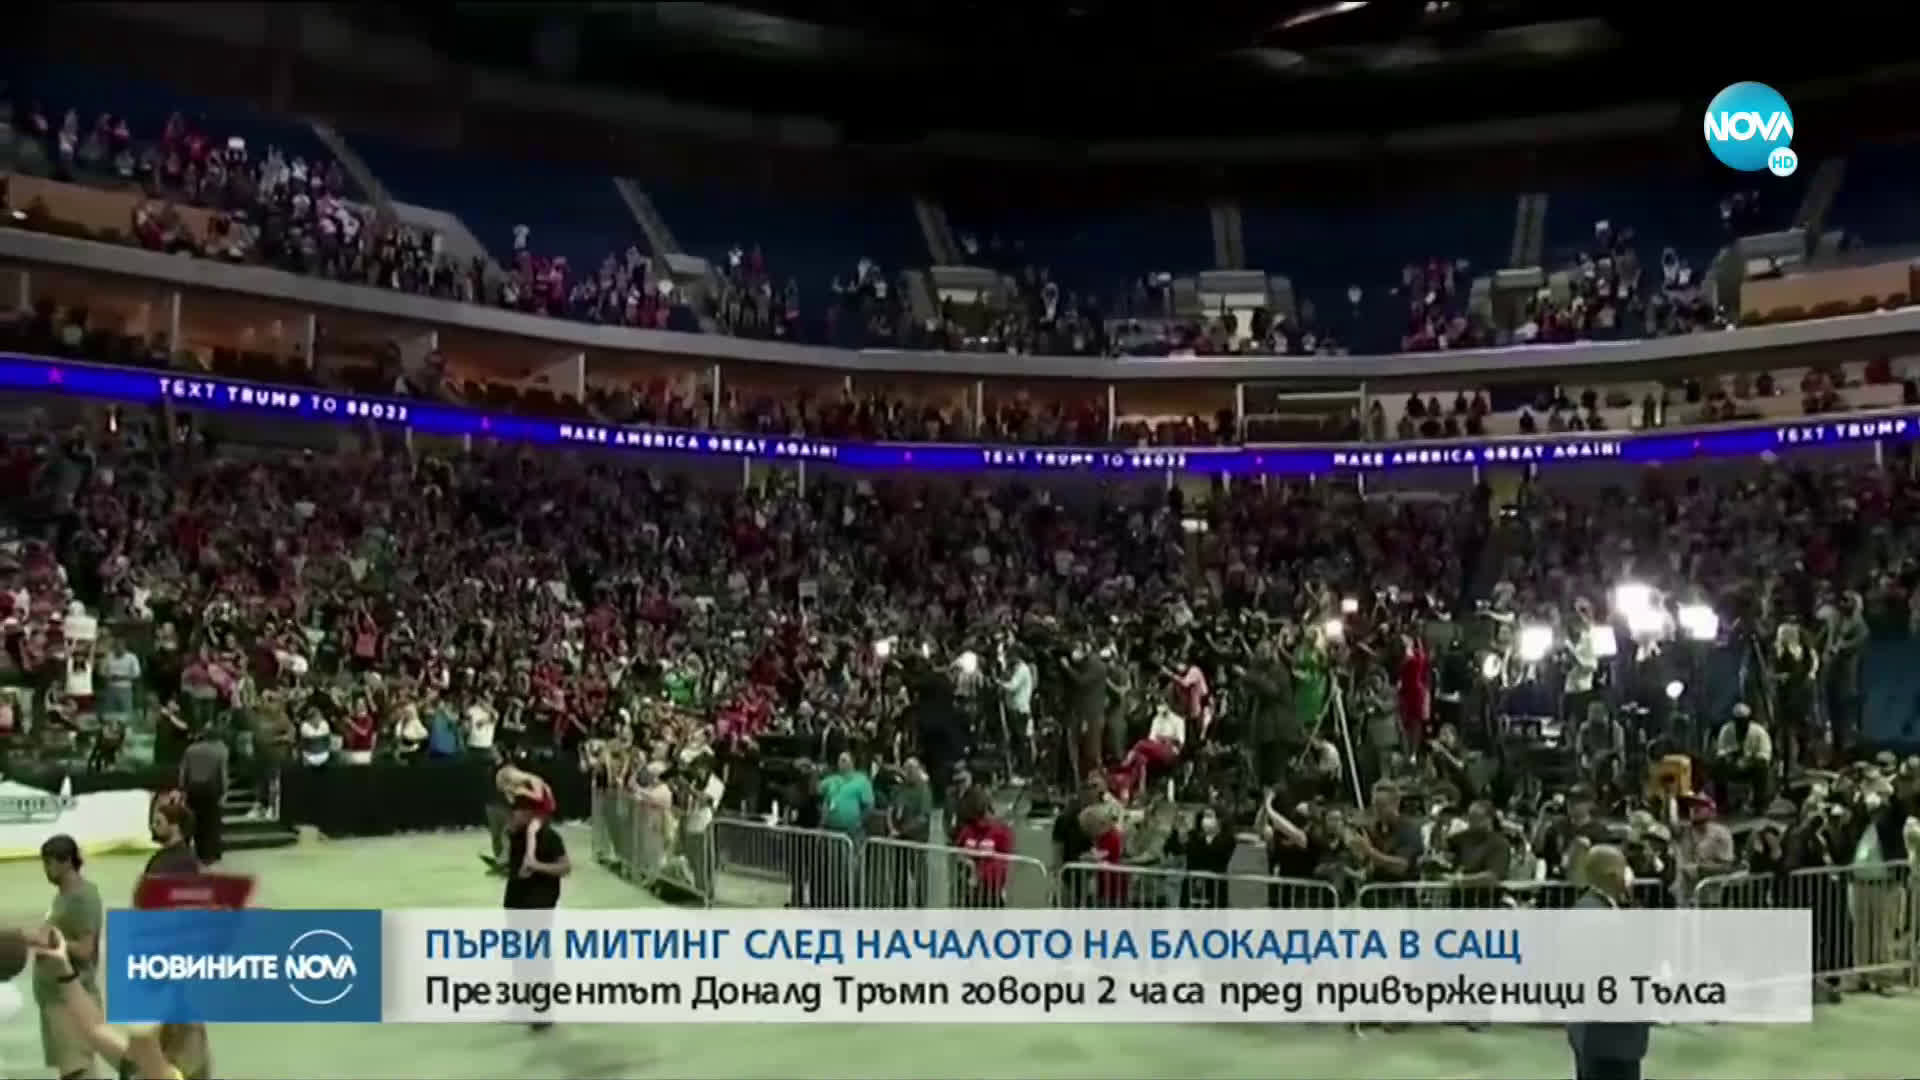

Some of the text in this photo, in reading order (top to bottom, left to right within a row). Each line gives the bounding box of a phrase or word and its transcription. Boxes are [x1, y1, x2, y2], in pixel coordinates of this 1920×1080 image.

[160, 378, 215, 399] TEXT
[227, 386, 301, 407] TRUMP
[312, 395, 337, 413] TO
[559, 424, 838, 458] MAKE AMERICA GREAT AGAIN!
[1777, 419, 1907, 442] TEXT TRUMP
[984, 450, 1025, 464] TEXT
[1035, 452, 1094, 466] TRUMP
[1103, 453, 1124, 467] TO
[1333, 441, 1622, 466] MAKE AMERICA GREAT AGAIN!
